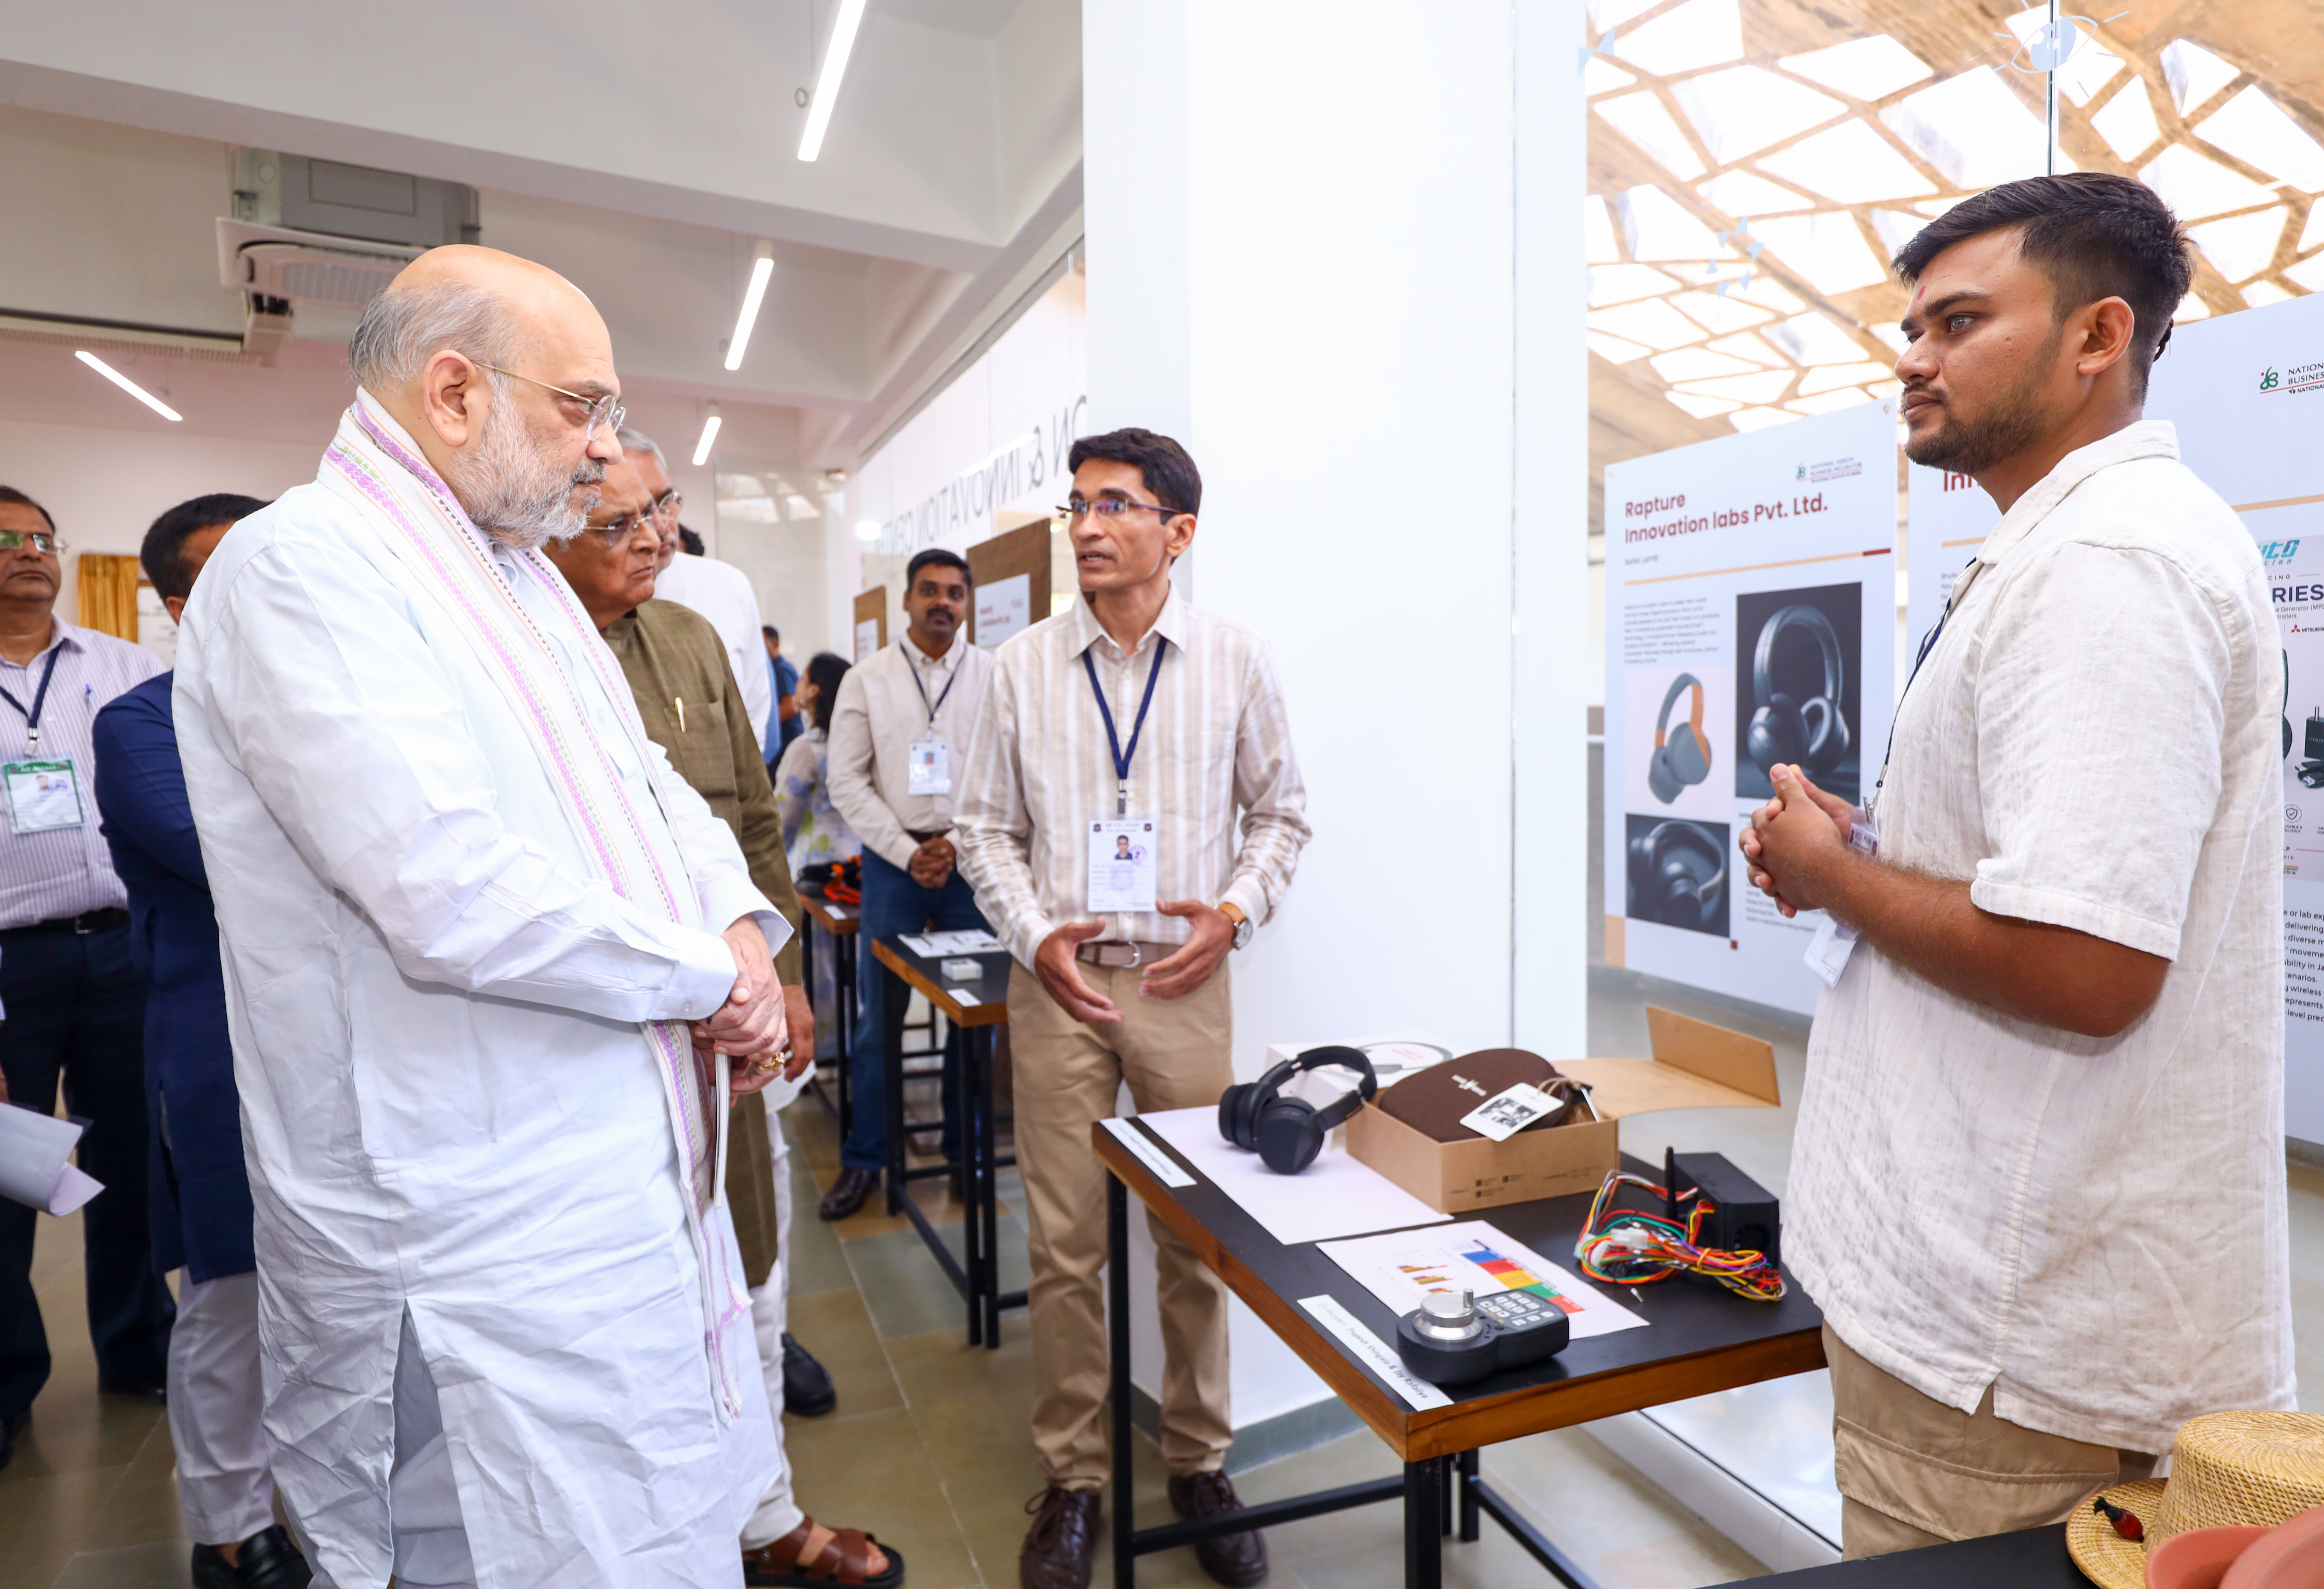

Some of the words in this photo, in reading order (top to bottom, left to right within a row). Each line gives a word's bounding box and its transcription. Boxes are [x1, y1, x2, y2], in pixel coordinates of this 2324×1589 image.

[2288, 362, 2324, 375] NATION
[1625, 494, 1685, 520] Rapture
[1625, 516, 1709, 544] Innovation
[1713, 508, 1749, 529] labs
[1754, 500, 1788, 523] Pvt.
[1794, 492, 1828, 515] Ltd.
[2272, 584, 2324, 603] RIES
[2300, 910, 2312, 918] lab
[2285, 921, 2324, 934] delivering
[2288, 934, 2316, 944] diverse
[2290, 948, 2324, 958] moveme
[2308, 962, 2315, 970] in
[2290, 985, 2321, 996] wireless
[2285, 998, 2323, 1009] epresents
[1393, 1370, 1403, 1378] Jay
